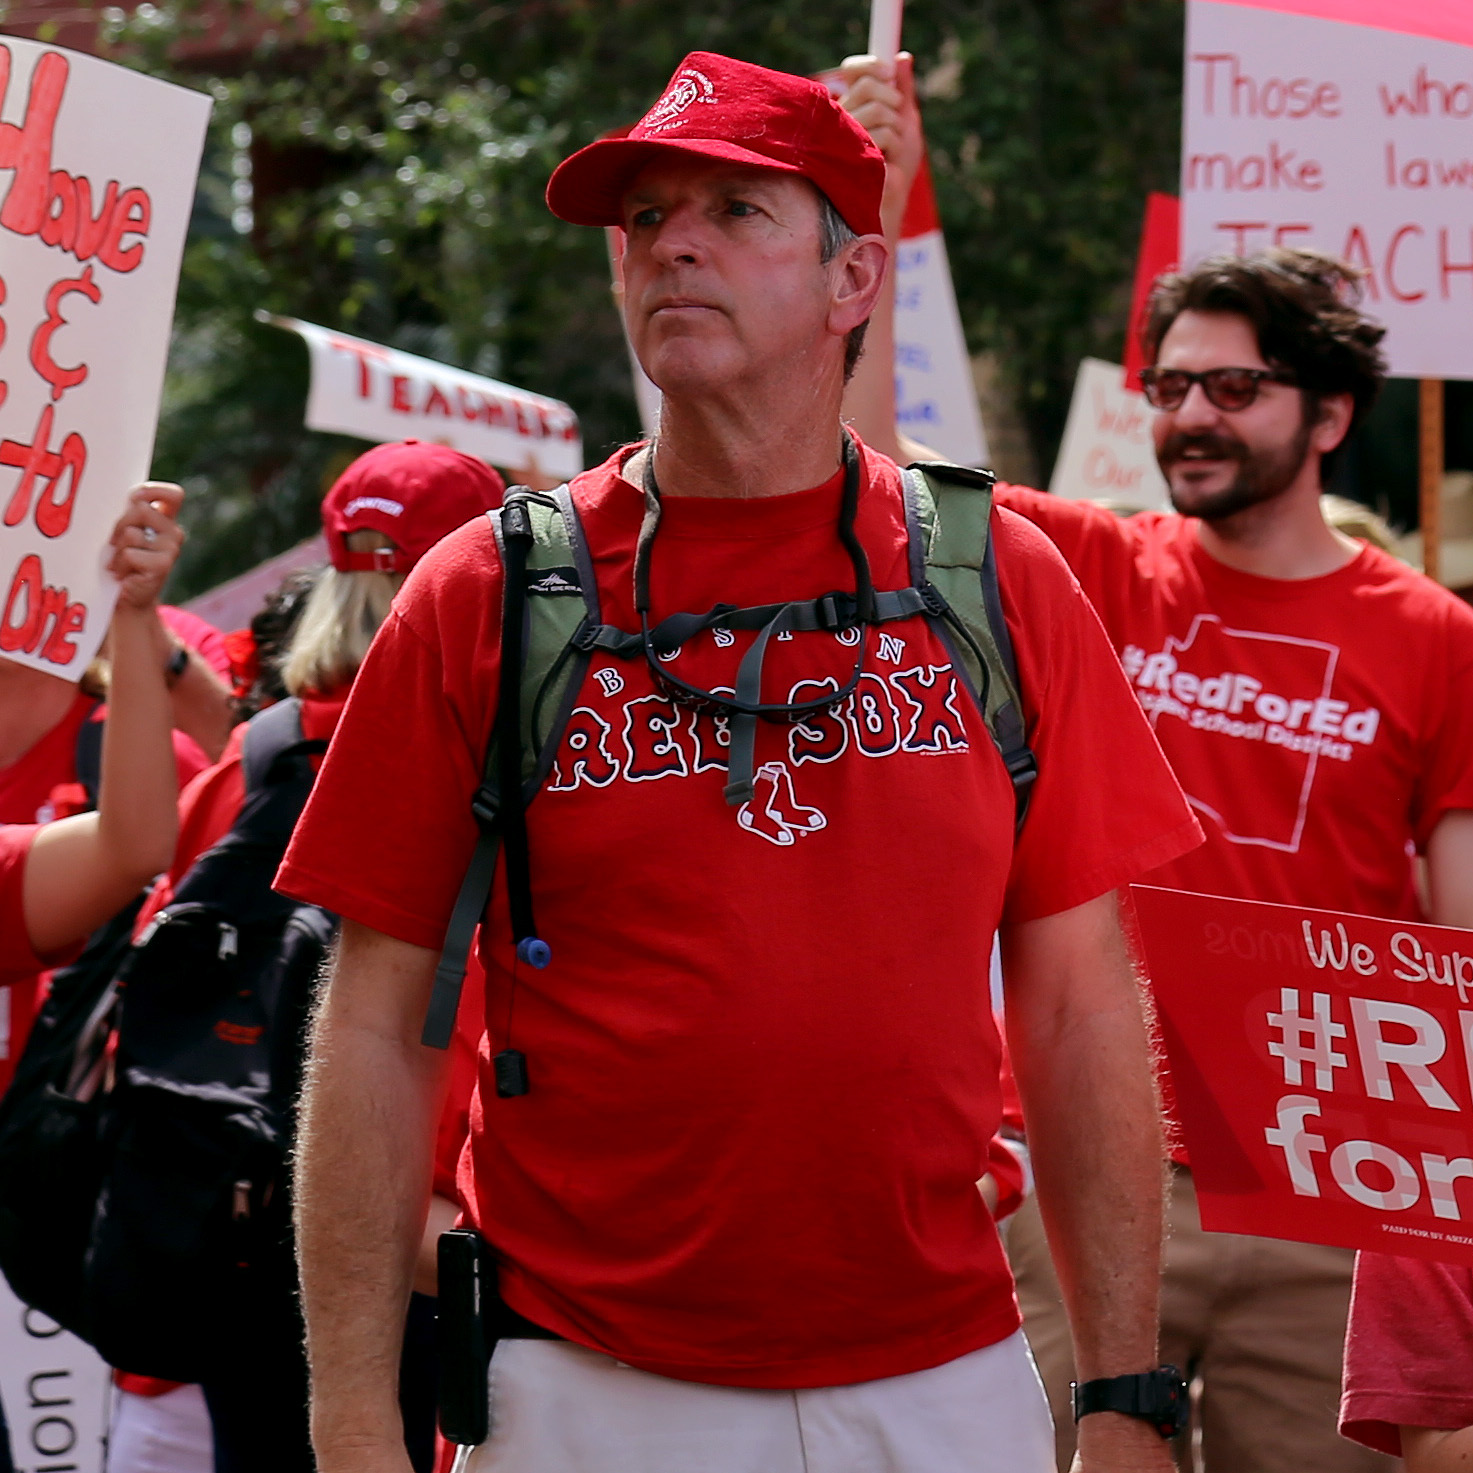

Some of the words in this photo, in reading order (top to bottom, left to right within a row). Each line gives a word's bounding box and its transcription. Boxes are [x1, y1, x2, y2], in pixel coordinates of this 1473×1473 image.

[1189, 52, 1342, 118] Those
[1186, 140, 1325, 192] make
[788, 663, 970, 768] SOX
[1123, 643, 1381, 745] #RedForEd
[1301, 919, 1377, 977] We
